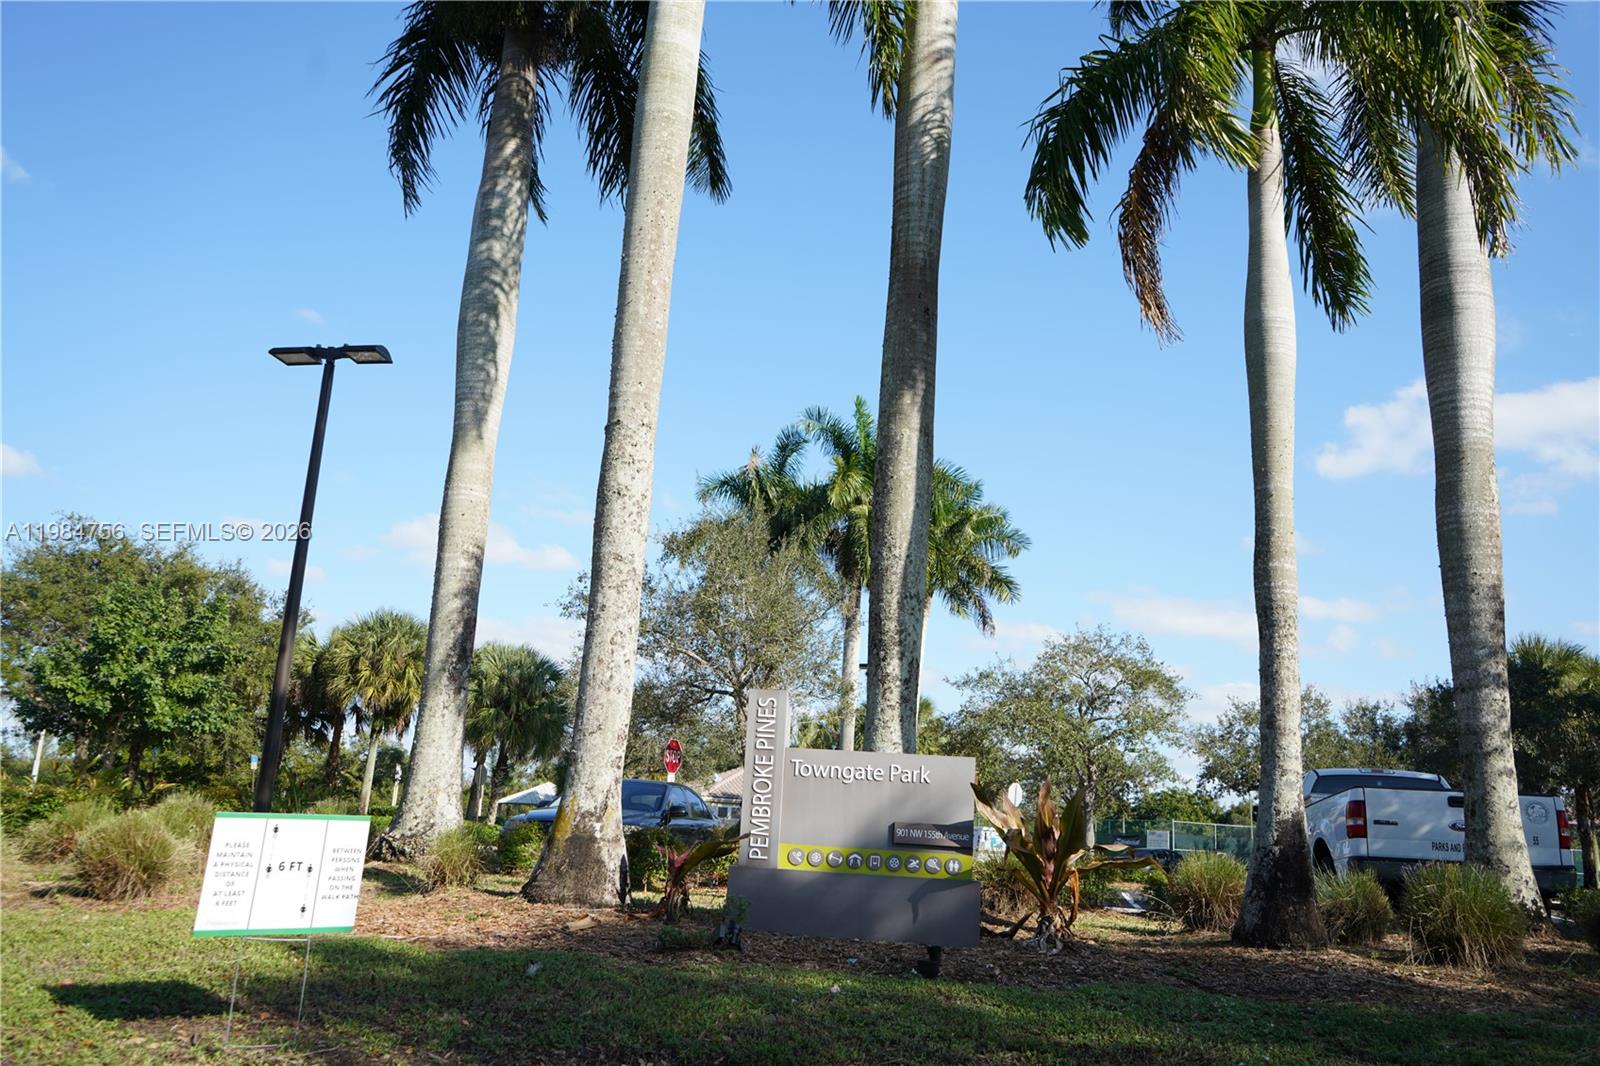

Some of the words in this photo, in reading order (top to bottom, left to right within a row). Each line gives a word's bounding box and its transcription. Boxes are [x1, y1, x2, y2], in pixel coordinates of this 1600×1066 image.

[757, 697, 777, 750] PINES
[666, 750, 681, 763] STOP
[791, 759, 884, 784] Towngate
[890, 764, 931, 784] Park
[749, 754, 775, 860] PEMBROKE
[896, 828, 908, 838] 901
[909, 829, 923, 839] NW
[924, 830, 943, 840] 155th
[943, 832, 970, 841] Avenue
[1431, 841, 1450, 852] PARKS
[1450, 843, 1461, 853] AND
[278, 861, 286, 872] 6
[289, 861, 304, 872] FT
[225, 880, 235, 888] OF
